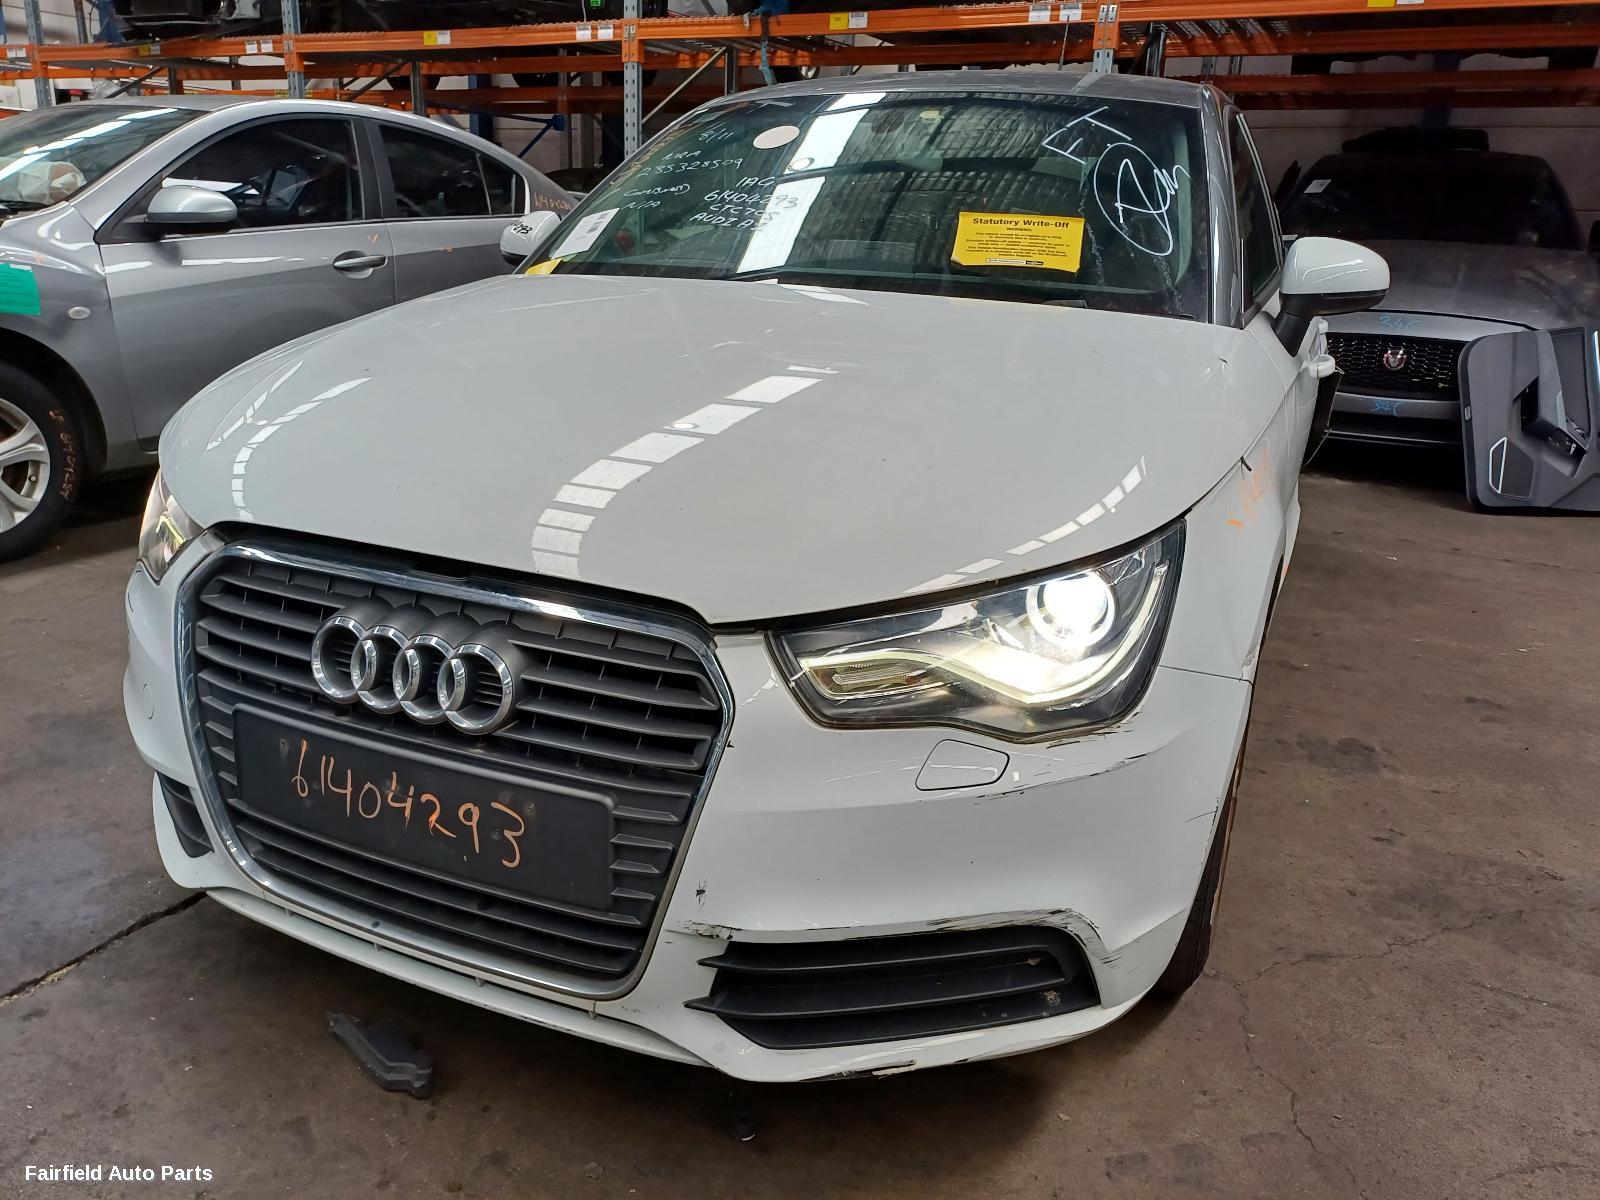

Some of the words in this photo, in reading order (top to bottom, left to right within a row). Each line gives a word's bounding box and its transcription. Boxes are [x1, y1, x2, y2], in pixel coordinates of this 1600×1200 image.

[703, 189, 799, 209] 61404293
[972, 217, 1020, 227] Statutory
[1022, 218, 1070, 229] Write-Off
[291, 738, 526, 868] 61404293
